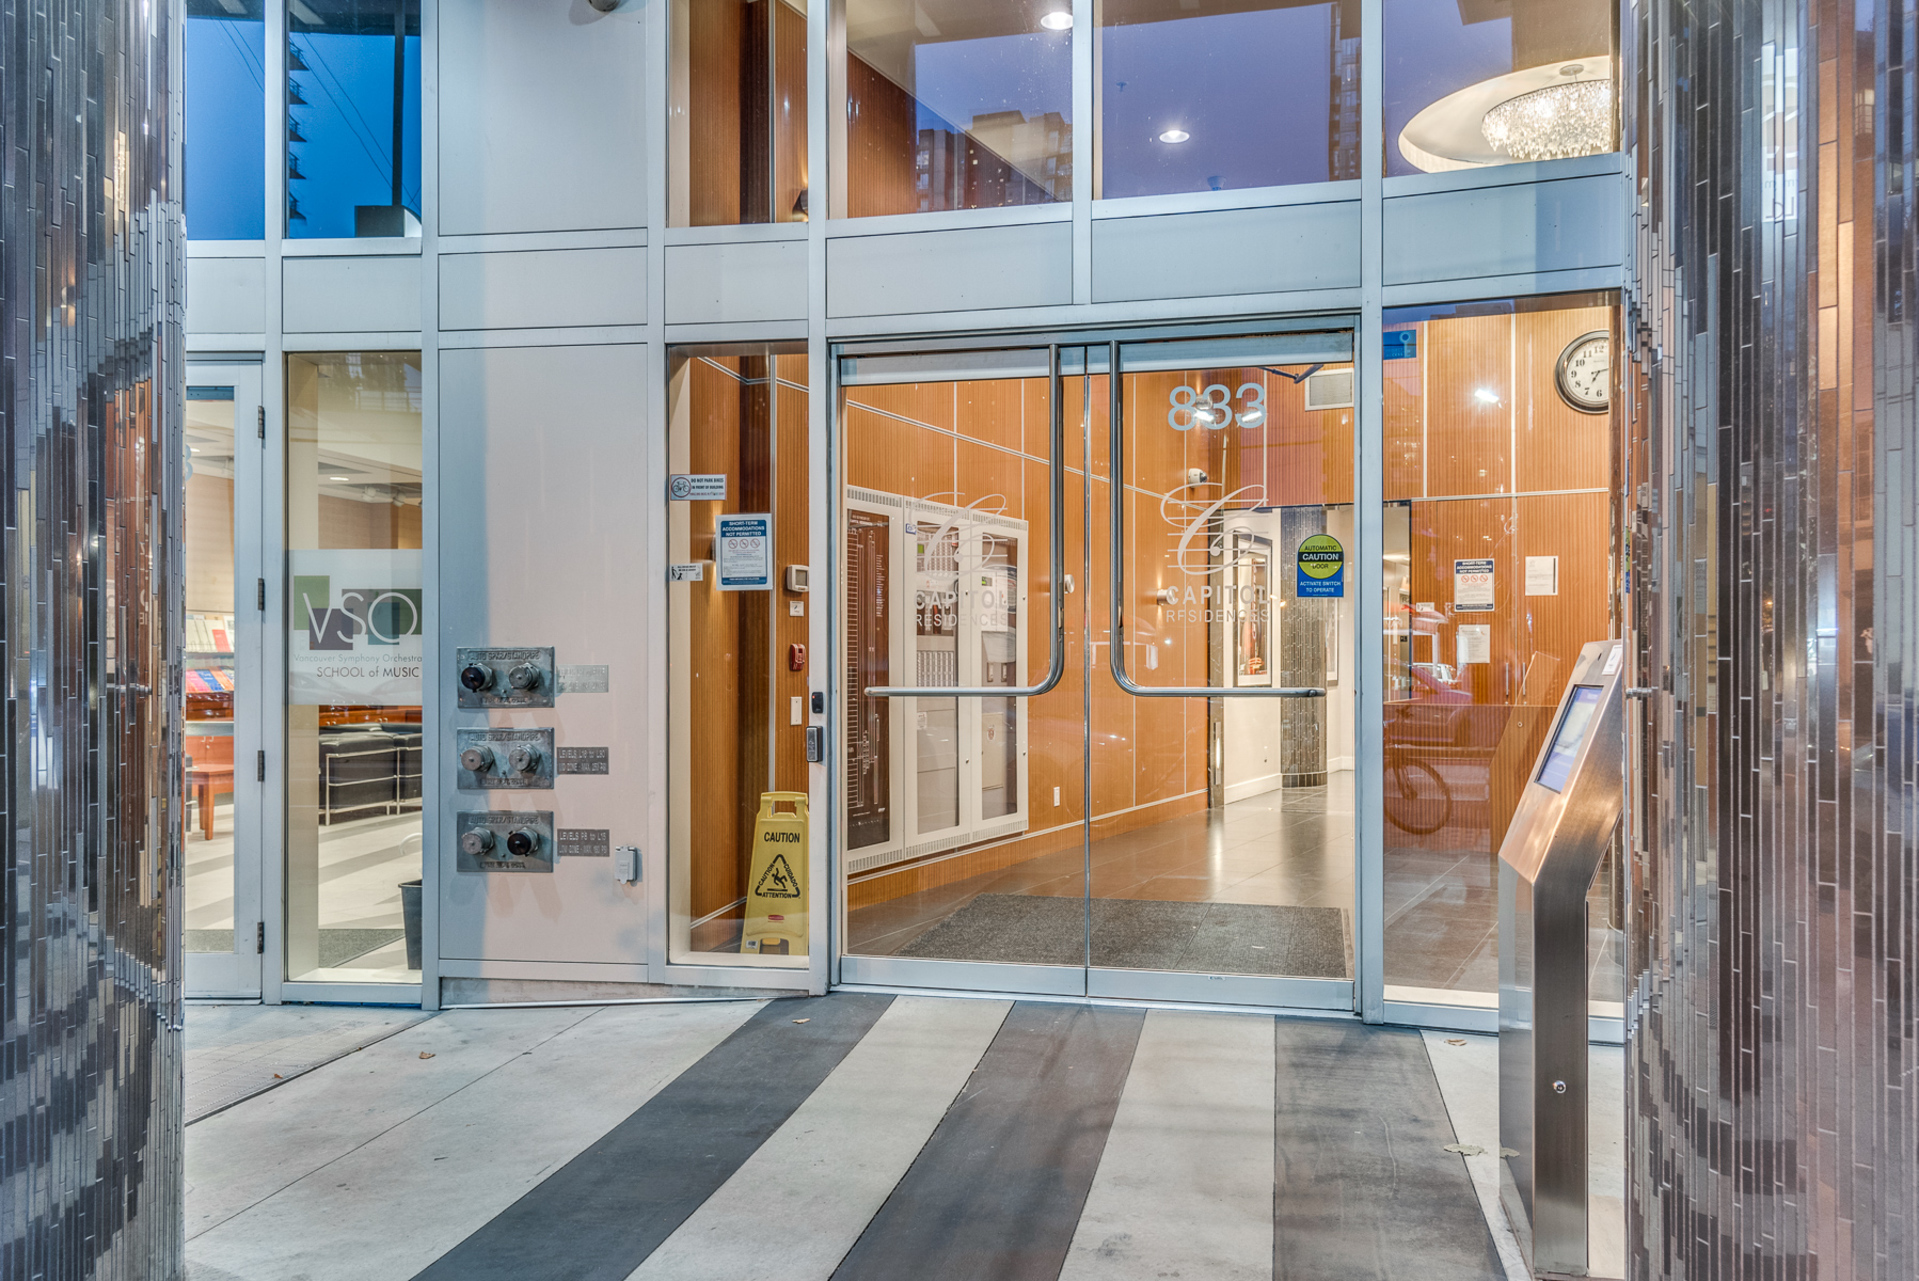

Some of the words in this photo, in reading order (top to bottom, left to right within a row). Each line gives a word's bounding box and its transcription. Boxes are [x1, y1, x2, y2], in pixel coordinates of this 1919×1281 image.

[1583, 350, 1592, 358] 11
[1594, 345, 1604, 353] 12
[1575, 359, 1585, 367] 10
[1571, 370, 1577, 378] 9
[1575, 380, 1581, 388] 8
[1584, 387, 1590, 395] 7
[1596, 389, 1602, 397] 6
[1168, 382, 1267, 431] 833
[915, 590, 1009, 610] CAPITOL
[1166, 585, 1270, 605] CAPITOL
[303, 592, 418, 644] VSO
[916, 613, 1008, 626] RESIDENCES
[1166, 609, 1269, 623] RESIDENCES
[294, 654, 335, 662] Vancouver
[338, 653, 380, 664] Symphony
[382, 653, 422, 662] Orchestra
[317, 667, 365, 677] SCHOOL
[368, 666, 380, 677] of
[383, 666, 419, 677] MUSIC
[559, 831, 579, 840] LEVELS
[764, 831, 800, 843] CAUTION
[758, 862, 775, 886] CAUTION
[783, 863, 798, 888] CUIDADO
